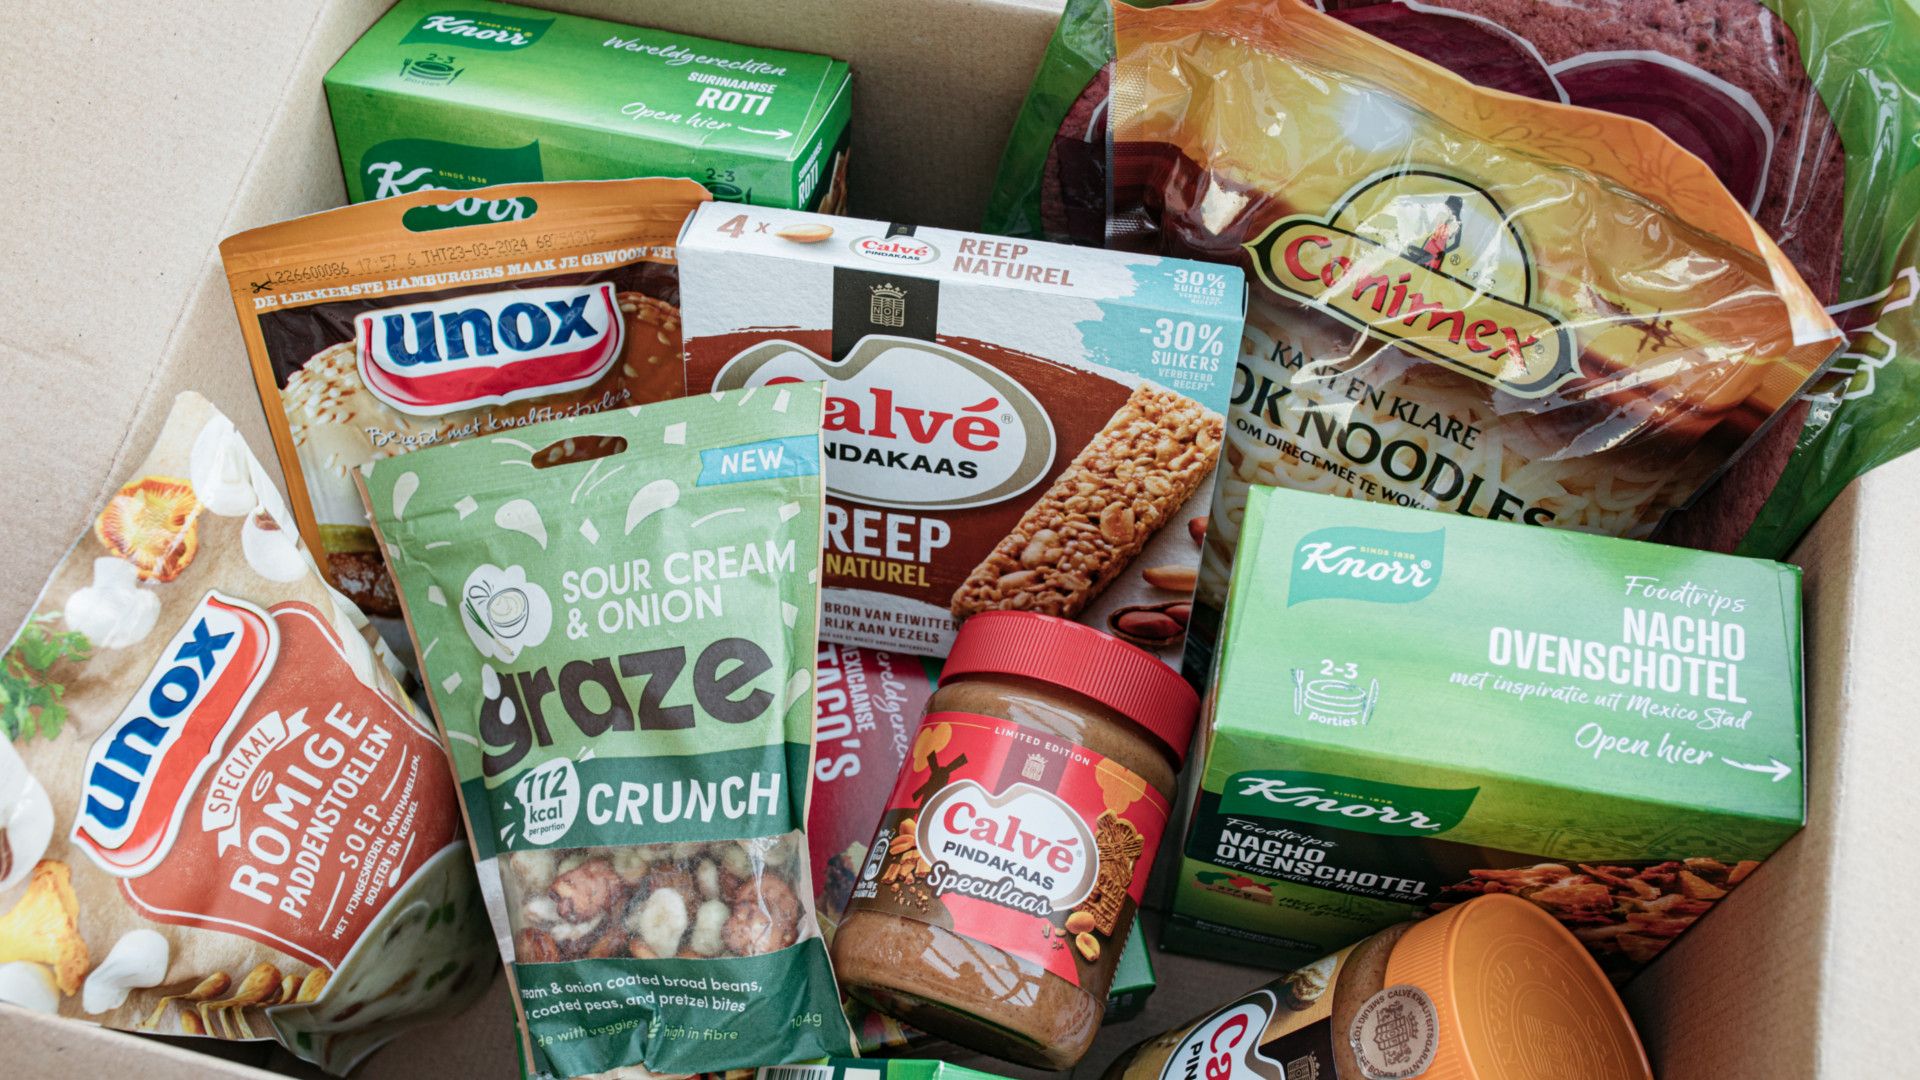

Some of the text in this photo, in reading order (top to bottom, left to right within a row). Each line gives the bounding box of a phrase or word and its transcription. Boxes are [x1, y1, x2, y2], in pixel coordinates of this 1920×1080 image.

[423, 16, 528, 45] Knorr
[426, 53, 456, 64] 2-3
[603, 35, 787, 77] Wereldgerechten
[687, 71, 778, 94] SURINAAMSE
[695, 87, 772, 116] ROTI
[621, 102, 731, 131] Open hier
[368, 161, 526, 221] Korr
[706, 168, 736, 182] 2-3
[716, 214, 749, 238] 4
[861, 240, 929, 257] Calvé
[864, 249, 921, 261] PINDAKAAS
[958, 237, 1029, 261] REEP
[253, 295, 278, 310] DE
[280, 281, 384, 306] LEKKERSTE
[386, 265, 504, 292] HAMBURGERS
[507, 258, 558, 279] MAAK
[559, 255, 583, 272] JE
[581, 247, 649, 269] GEWOON
[953, 255, 1075, 288] NATUREL
[1163, 267, 1226, 291] -30%
[1173, 282, 1225, 298] SUIKERS
[382, 295, 599, 367] unox
[1139, 318, 1225, 357] -30%
[1151, 350, 1221, 372] SUIKERS
[1229, 361, 1292, 429] OK
[1343, 373, 1386, 410] EN
[1388, 396, 1483, 452] KLARE
[365, 427, 445, 449] Bereid
[446, 420, 483, 441] met
[822, 387, 1001, 452] alvé
[721, 445, 784, 476] NEW
[823, 445, 980, 480] NDAKAAS
[1236, 417, 1262, 441] OM
[1264, 434, 1321, 467] DIRECT
[1321, 462, 1358, 488] MEE
[1358, 476, 1379, 497] TE
[823, 503, 952, 564] REEP
[561, 539, 797, 604] SOUR CREAM
[825, 553, 931, 588] NATUREL
[1299, 541, 1432, 588] Knorr
[567, 585, 724, 642] & ONION
[1623, 574, 1748, 617] Foodtrips
[824, 602, 966, 635] BRON VAN EIWITTEN
[824, 617, 857, 632] RIJK
[858, 624, 885, 637] AAN
[889, 627, 941, 645] VEZELS
[1622, 606, 1746, 662] NACHO
[1319, 657, 1359, 680] 2-3
[1488, 626, 1748, 705] OVENSCHOTEL
[479, 637, 775, 778] graze
[1448, 669, 1754, 731] met inspiratie uit Mexico Stad
[86, 616, 236, 830] unox
[994, 726, 1091, 766] LIMITED EDITION
[1573, 722, 1715, 765] Open hier
[208, 727, 276, 815] SPECIAAL
[524, 766, 569, 804] 112
[230, 702, 369, 905] ROMIGE
[529, 799, 564, 825] kcal
[587, 771, 782, 826] CRUNCH
[1237, 777, 1442, 834] Knorr
[279, 723, 394, 919] PADDENSTOELEN
[339, 803, 383, 870] SOEP
[528, 822, 566, 841] per portion
[943, 802, 1079, 874] Calvé
[1225, 816, 1340, 849] Foodtrips
[332, 916, 350, 941] MET
[381, 754, 422, 837] CANTHARELLEN,
[364, 800, 419, 907] BOLETEN EN KERVEL
[941, 840, 1054, 891] PINDAKAAS
[1212, 855, 1240, 870] met
[1220, 828, 1327, 866] NACHO
[931, 865, 1050, 916] Speculaas
[1215, 845, 1431, 900] OVENSCHOTEL
[550, 982, 564, 996] &
[564, 981, 602, 994] onion
[606, 974, 660, 989] coated
[661, 975, 708, 991] broad
[709, 977, 763, 993] beans,
[532, 999, 583, 1019] coated
[583, 997, 624, 1015] peas,
[625, 991, 656, 1007] and
[658, 992, 709, 1010] pretzel
[711, 996, 748, 1014] bites
[790, 1011, 822, 1030] 104g
[557, 1025, 587, 1043] with
[588, 1018, 639, 1040] veggies
[663, 1025, 688, 1042] high
[687, 1027, 700, 1040] in
[703, 1027, 739, 1041] fibre
